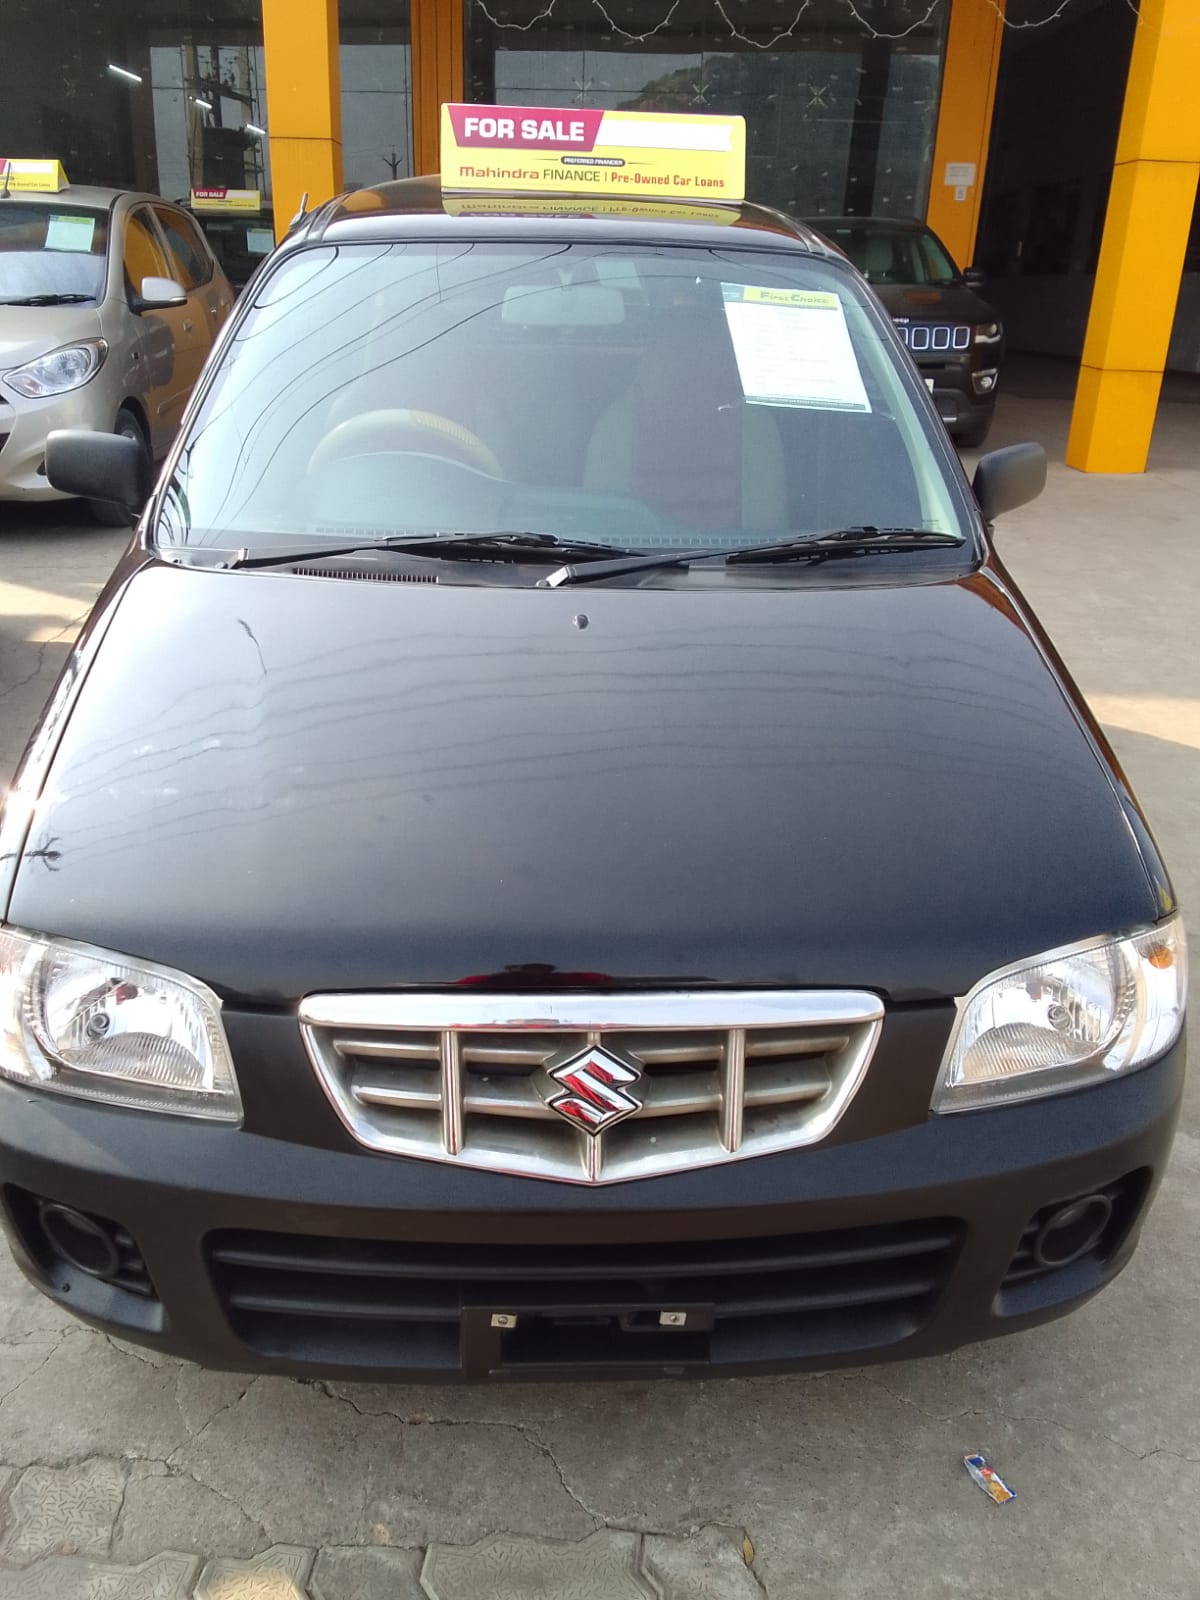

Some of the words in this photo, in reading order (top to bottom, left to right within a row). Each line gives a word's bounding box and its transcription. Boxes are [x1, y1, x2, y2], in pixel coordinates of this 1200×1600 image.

[464, 117, 515, 139] FOR
[521, 119, 585, 142] SALE
[459, 166, 540, 180] Mahindra
[543, 168, 601, 182] FINANCE
[611, 171, 670, 185] Pre-Owned
[673, 174, 692, 186] Car
[695, 176, 725, 188] Loans
